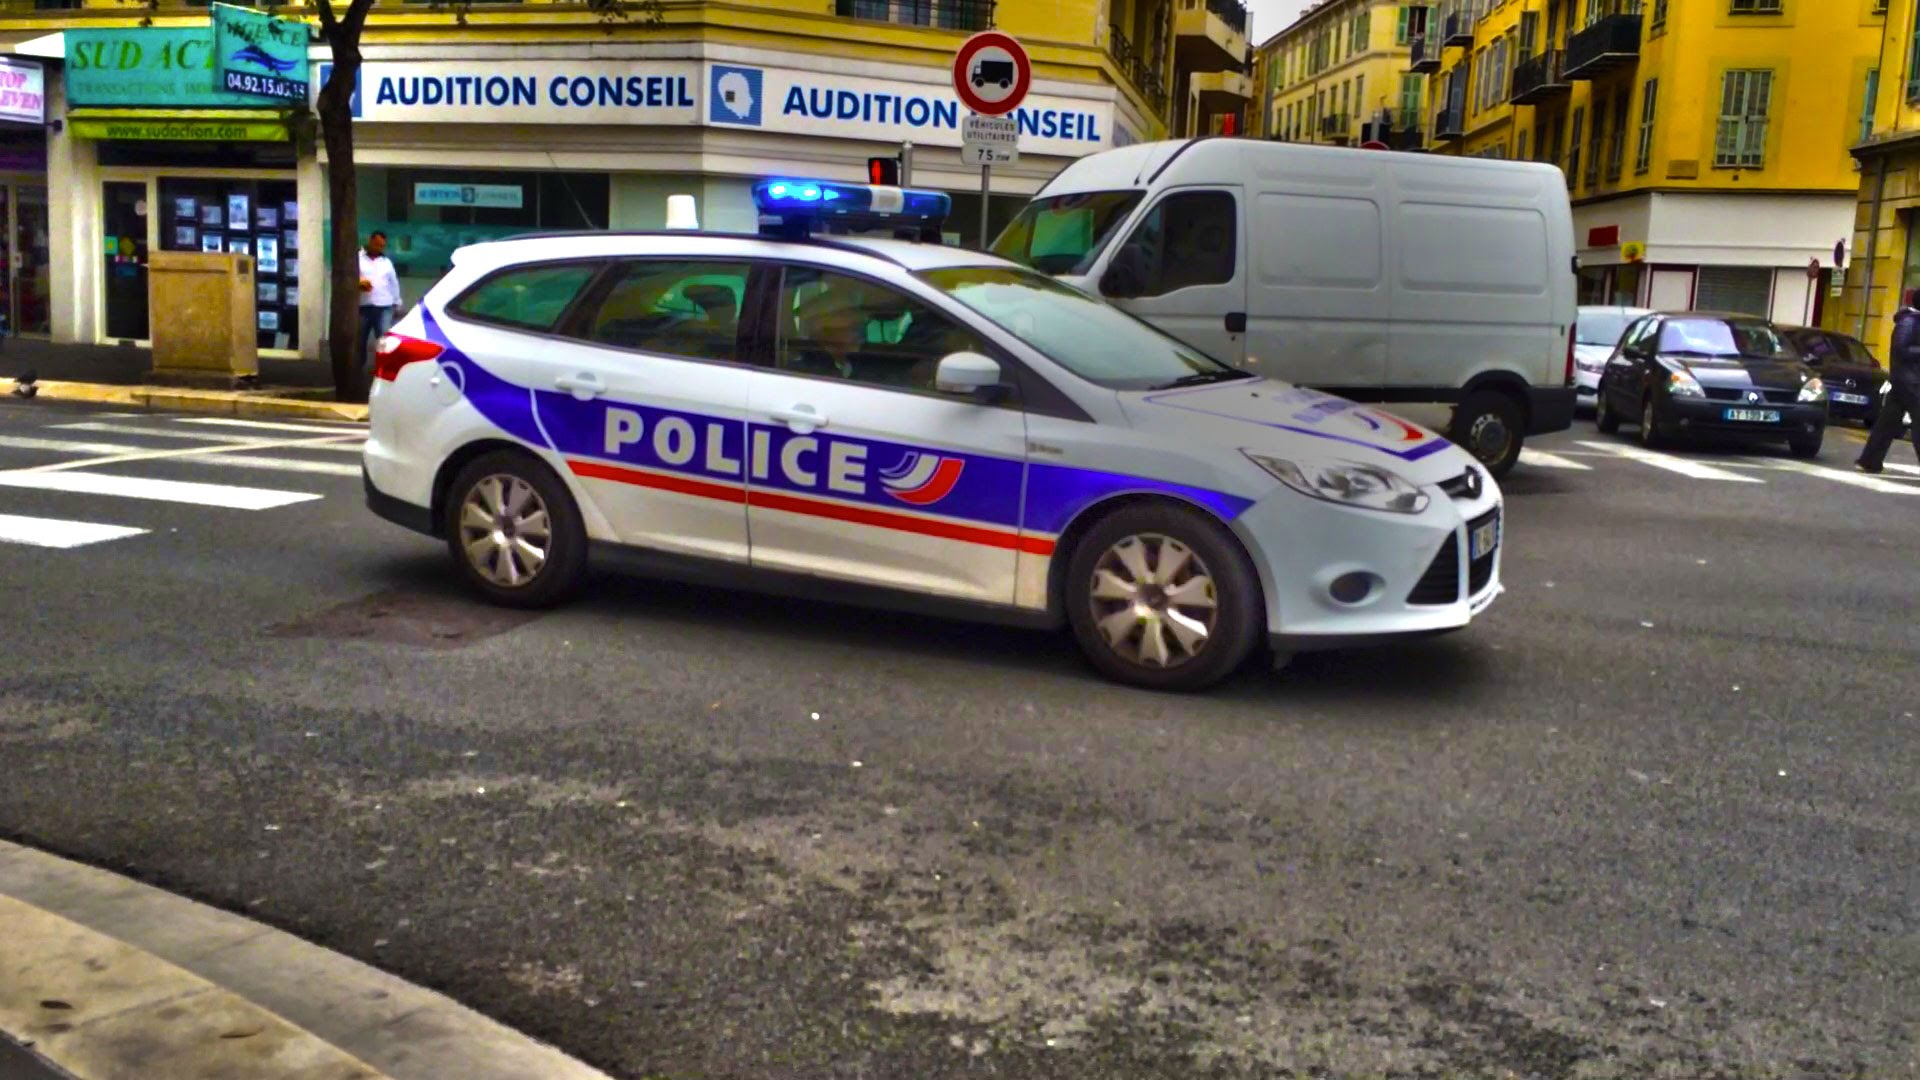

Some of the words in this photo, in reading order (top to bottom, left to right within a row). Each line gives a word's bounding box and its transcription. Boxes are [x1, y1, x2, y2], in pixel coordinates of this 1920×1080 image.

[71, 40, 143, 70] SUD
[376, 76, 537, 106] AUDITION
[549, 76, 694, 107] CONSEIL
[783, 86, 957, 130] AUDITION
[970, 107, 1101, 142] NSEIL
[106, 122, 247, 139] www.sudaction.com
[605, 407, 868, 494] POLICE
